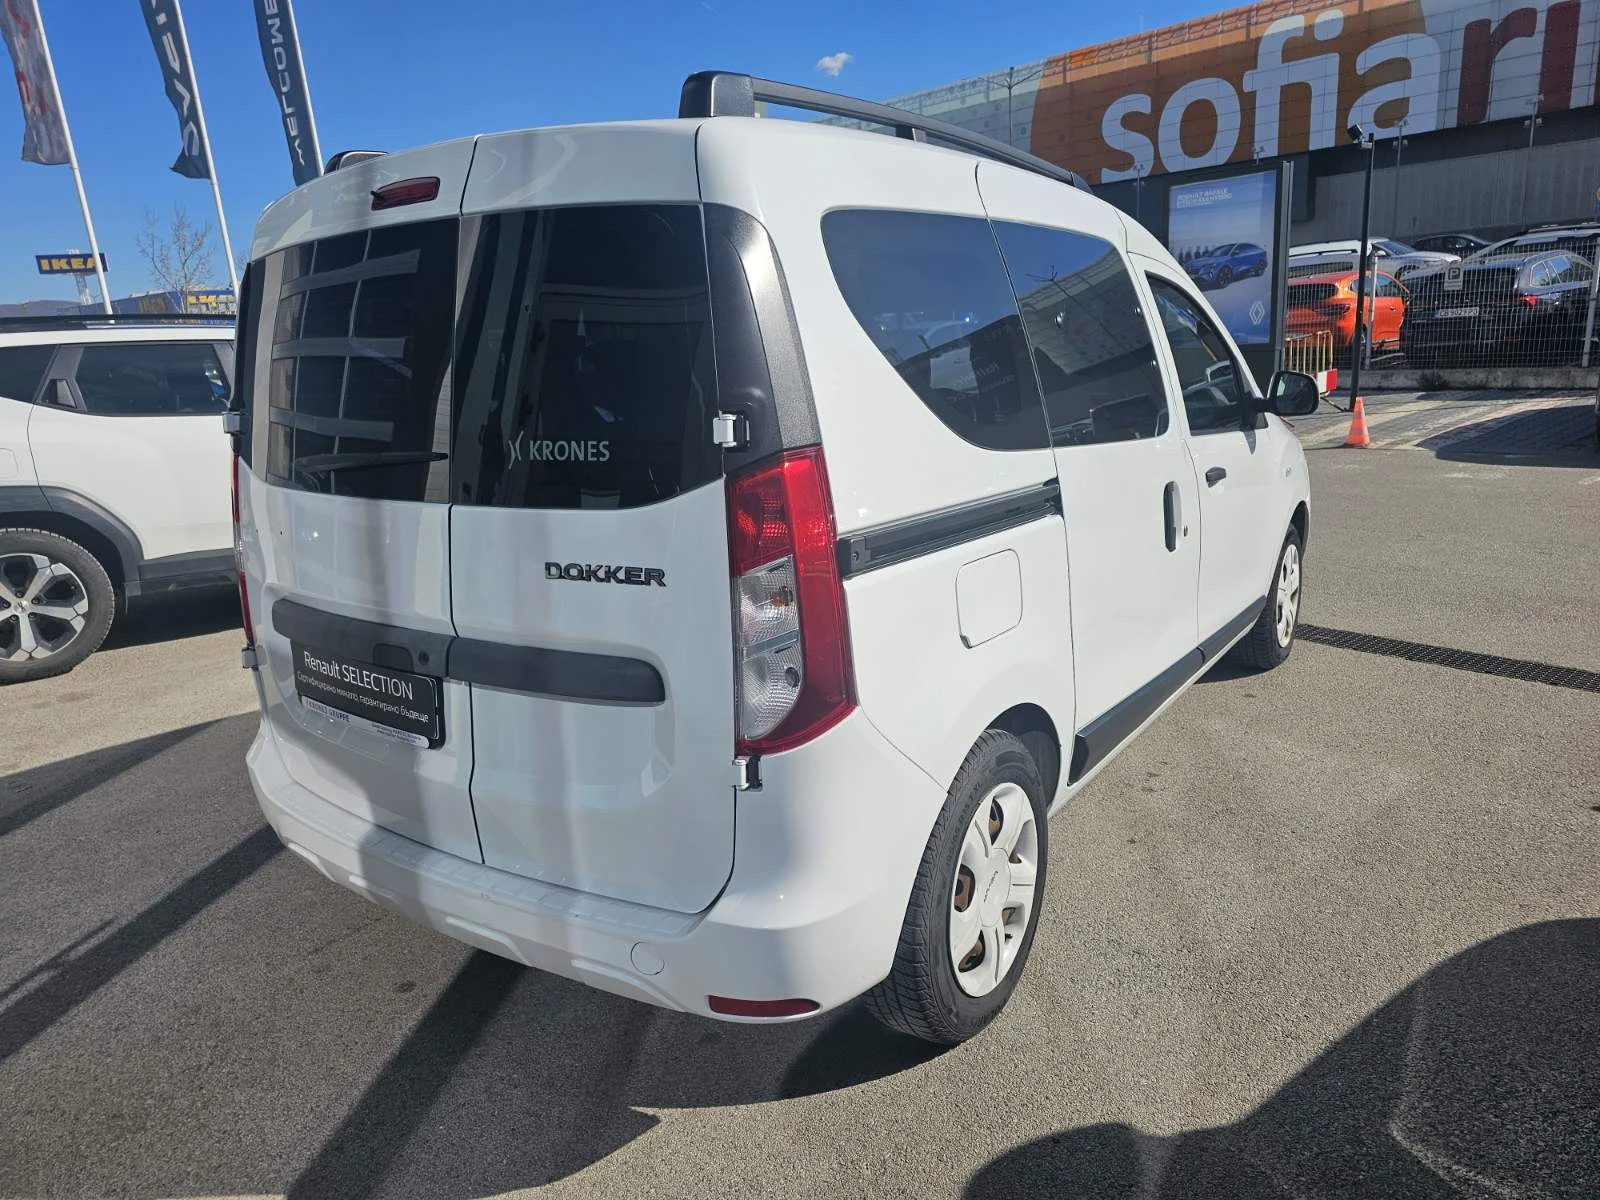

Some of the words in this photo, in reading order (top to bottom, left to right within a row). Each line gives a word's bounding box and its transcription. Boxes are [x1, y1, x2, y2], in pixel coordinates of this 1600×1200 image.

[529, 440, 610, 462] KRONES
[545, 562, 667, 587] DOKKER
[304, 650, 341, 680] Renault
[342, 664, 413, 701] SELECTION
[400, 705, 429, 723] бъдеще
